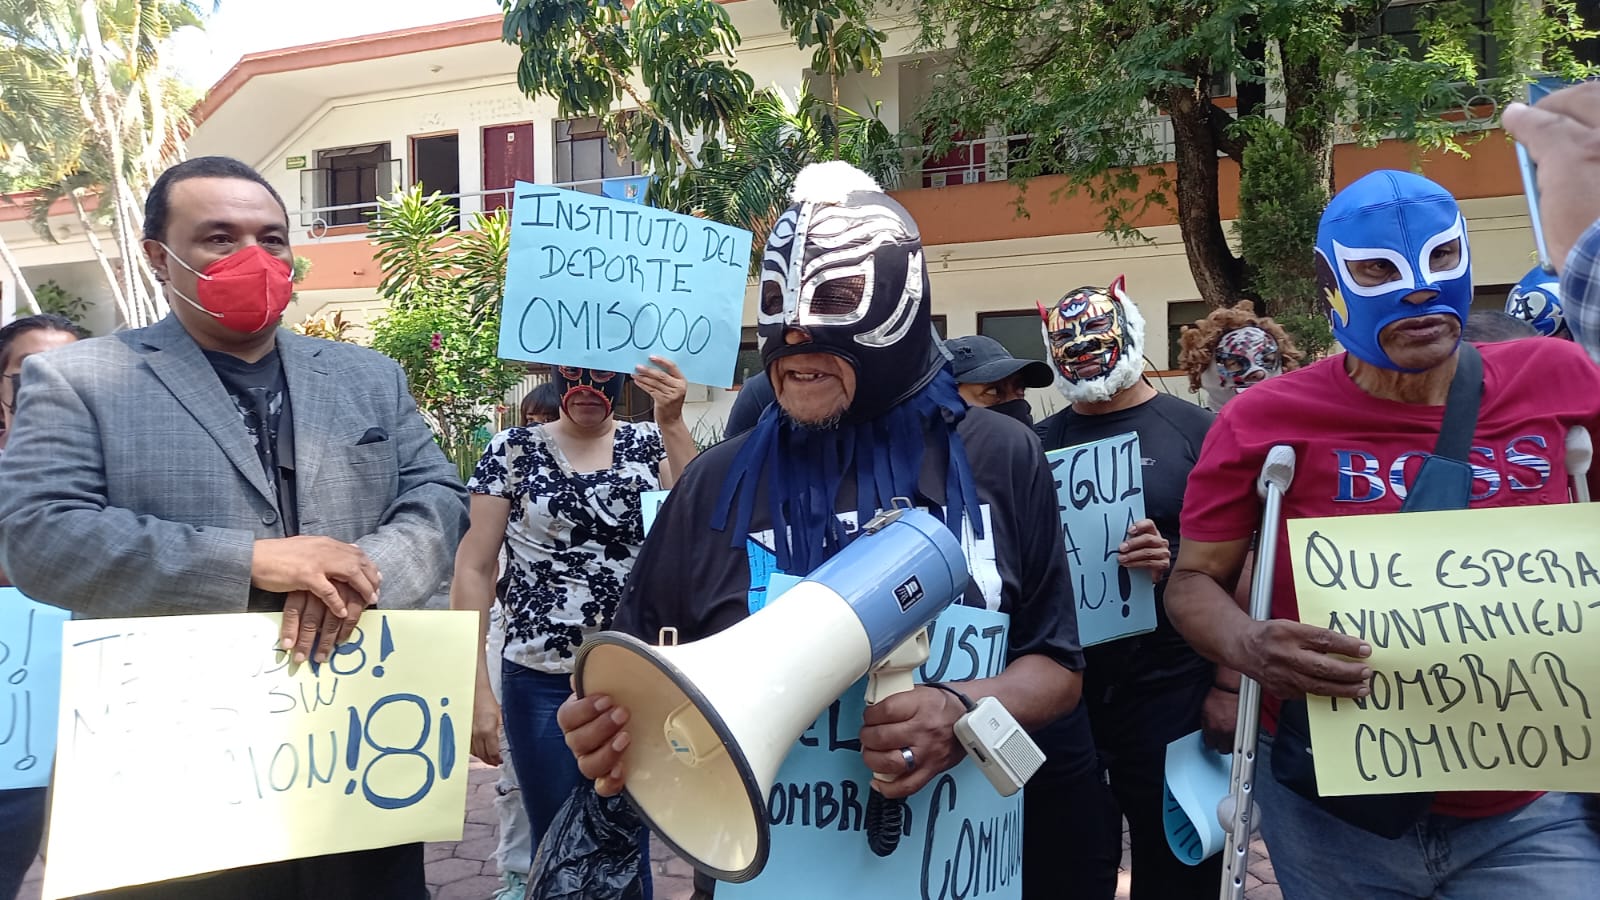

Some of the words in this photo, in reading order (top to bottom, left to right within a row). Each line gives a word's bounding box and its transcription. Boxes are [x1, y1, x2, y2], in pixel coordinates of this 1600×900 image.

[519, 193, 688, 253] INSTITUTO
[702, 226, 742, 268] DEL
[539, 245, 693, 292] DEPORTE
[1305, 531, 1413, 590] QUE
[1436, 549, 1600, 589] ESPERA
[1328, 599, 1600, 649] AYUNTAMIEN
[269, 678, 338, 713] SIN
[1355, 721, 1592, 781] COMICION
